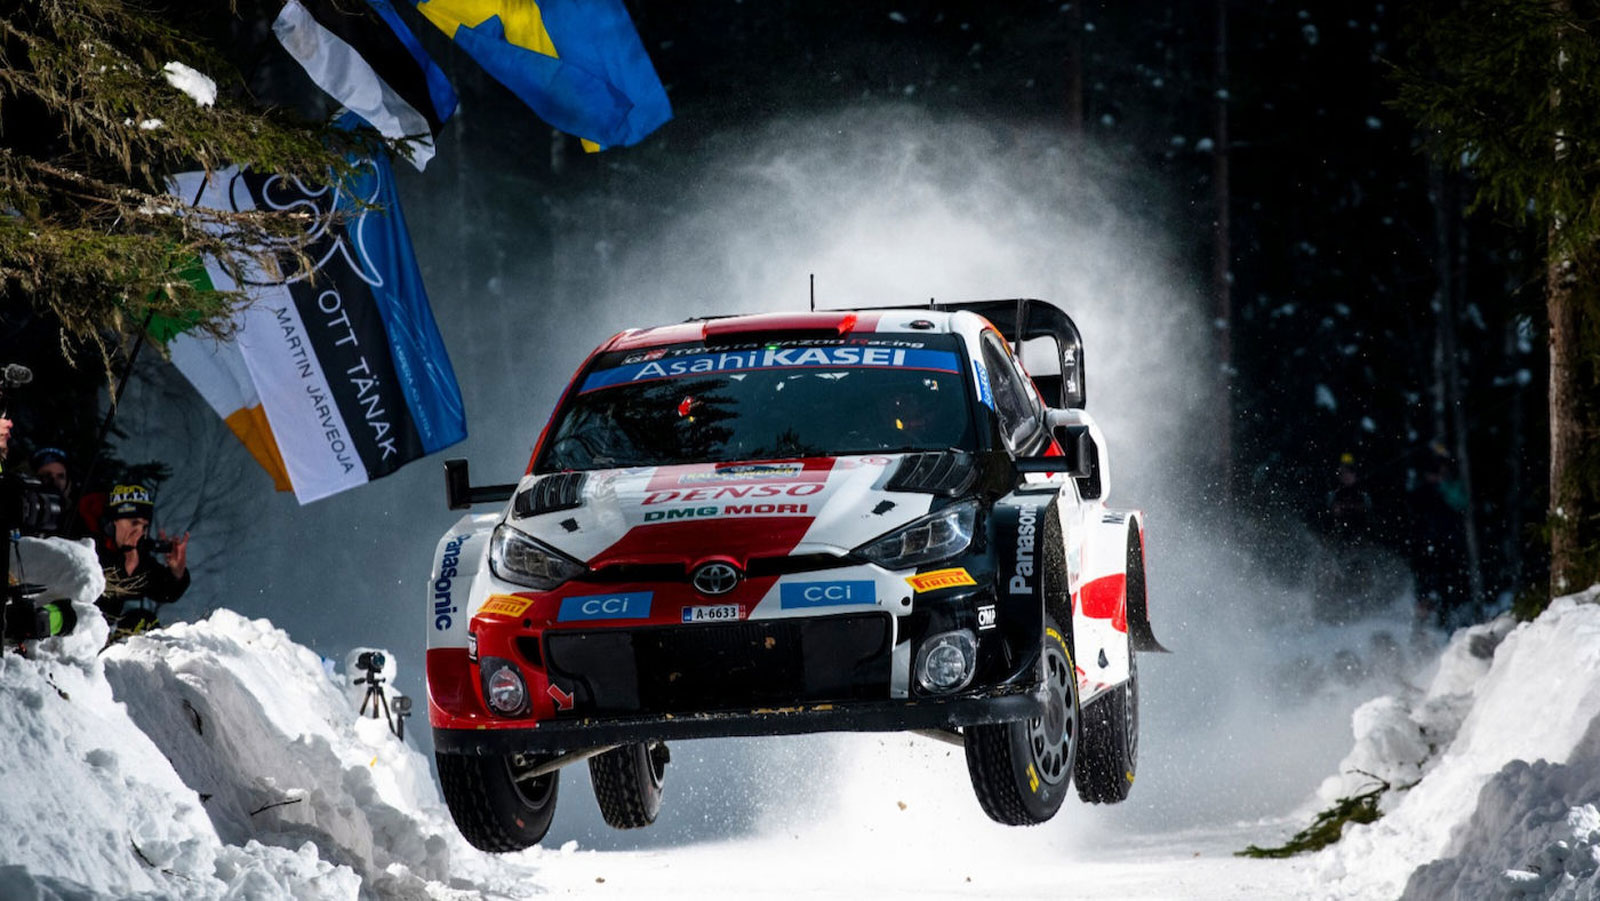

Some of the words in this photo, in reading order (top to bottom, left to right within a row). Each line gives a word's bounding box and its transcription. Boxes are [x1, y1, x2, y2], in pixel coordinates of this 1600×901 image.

[850, 338, 925, 349] Racing
[318, 290, 358, 346] OTT
[347, 356, 398, 460] TÄNAK
[276, 307, 314, 379] MARTIN
[306, 383, 354, 474] JÄRVEOJA
[641, 483, 826, 506] DENSO
[643, 505, 719, 522] DMG
[723, 503, 808, 515] MORI
[434, 534, 472, 631] Panasonic
[911, 571, 970, 590] PIRELLI
[696, 607, 737, 620] A-6633
[977, 609, 997, 626] OMP
